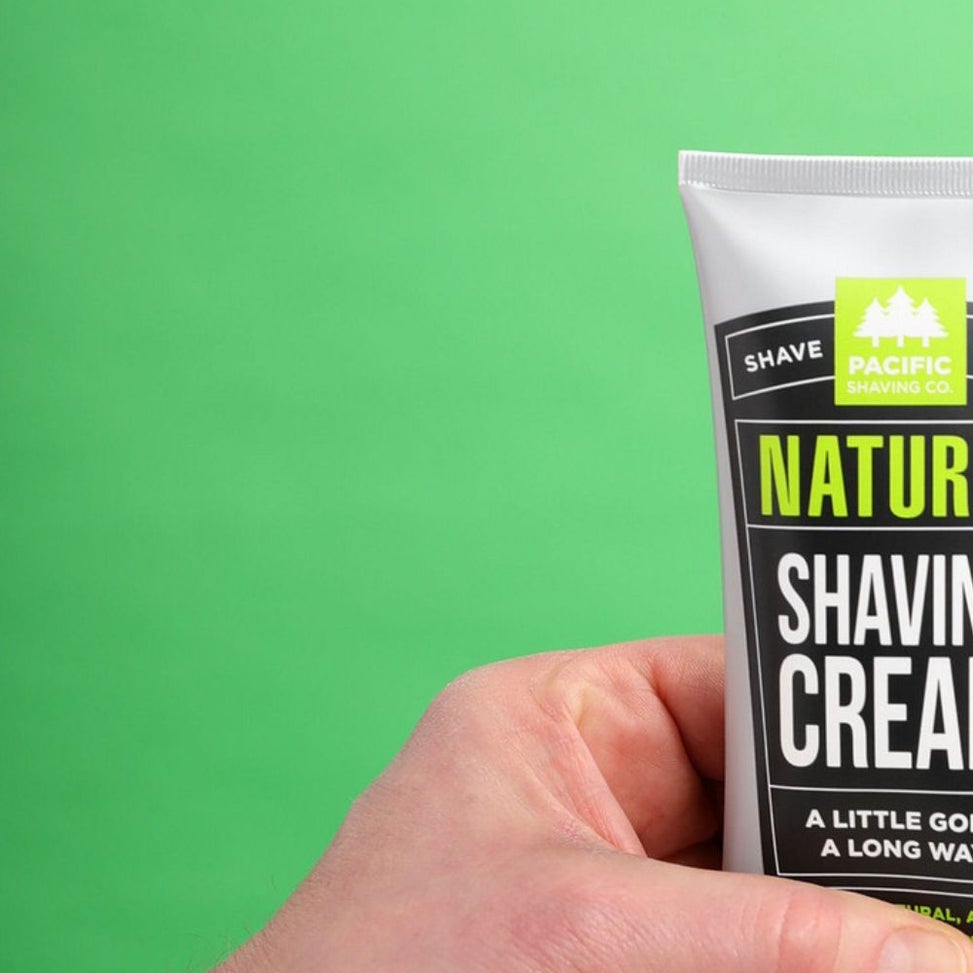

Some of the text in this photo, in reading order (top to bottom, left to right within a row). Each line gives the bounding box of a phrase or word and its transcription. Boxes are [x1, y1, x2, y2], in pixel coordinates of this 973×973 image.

[744, 340, 823, 372] SHAVE
[848, 356, 952, 376] PACIFIC
[847, 380, 953, 394] SHAVING CO.
[806, 809, 826, 828] A
[833, 810, 922, 831] LITTLE
[821, 839, 841, 857] A
[848, 839, 922, 860] LONG
